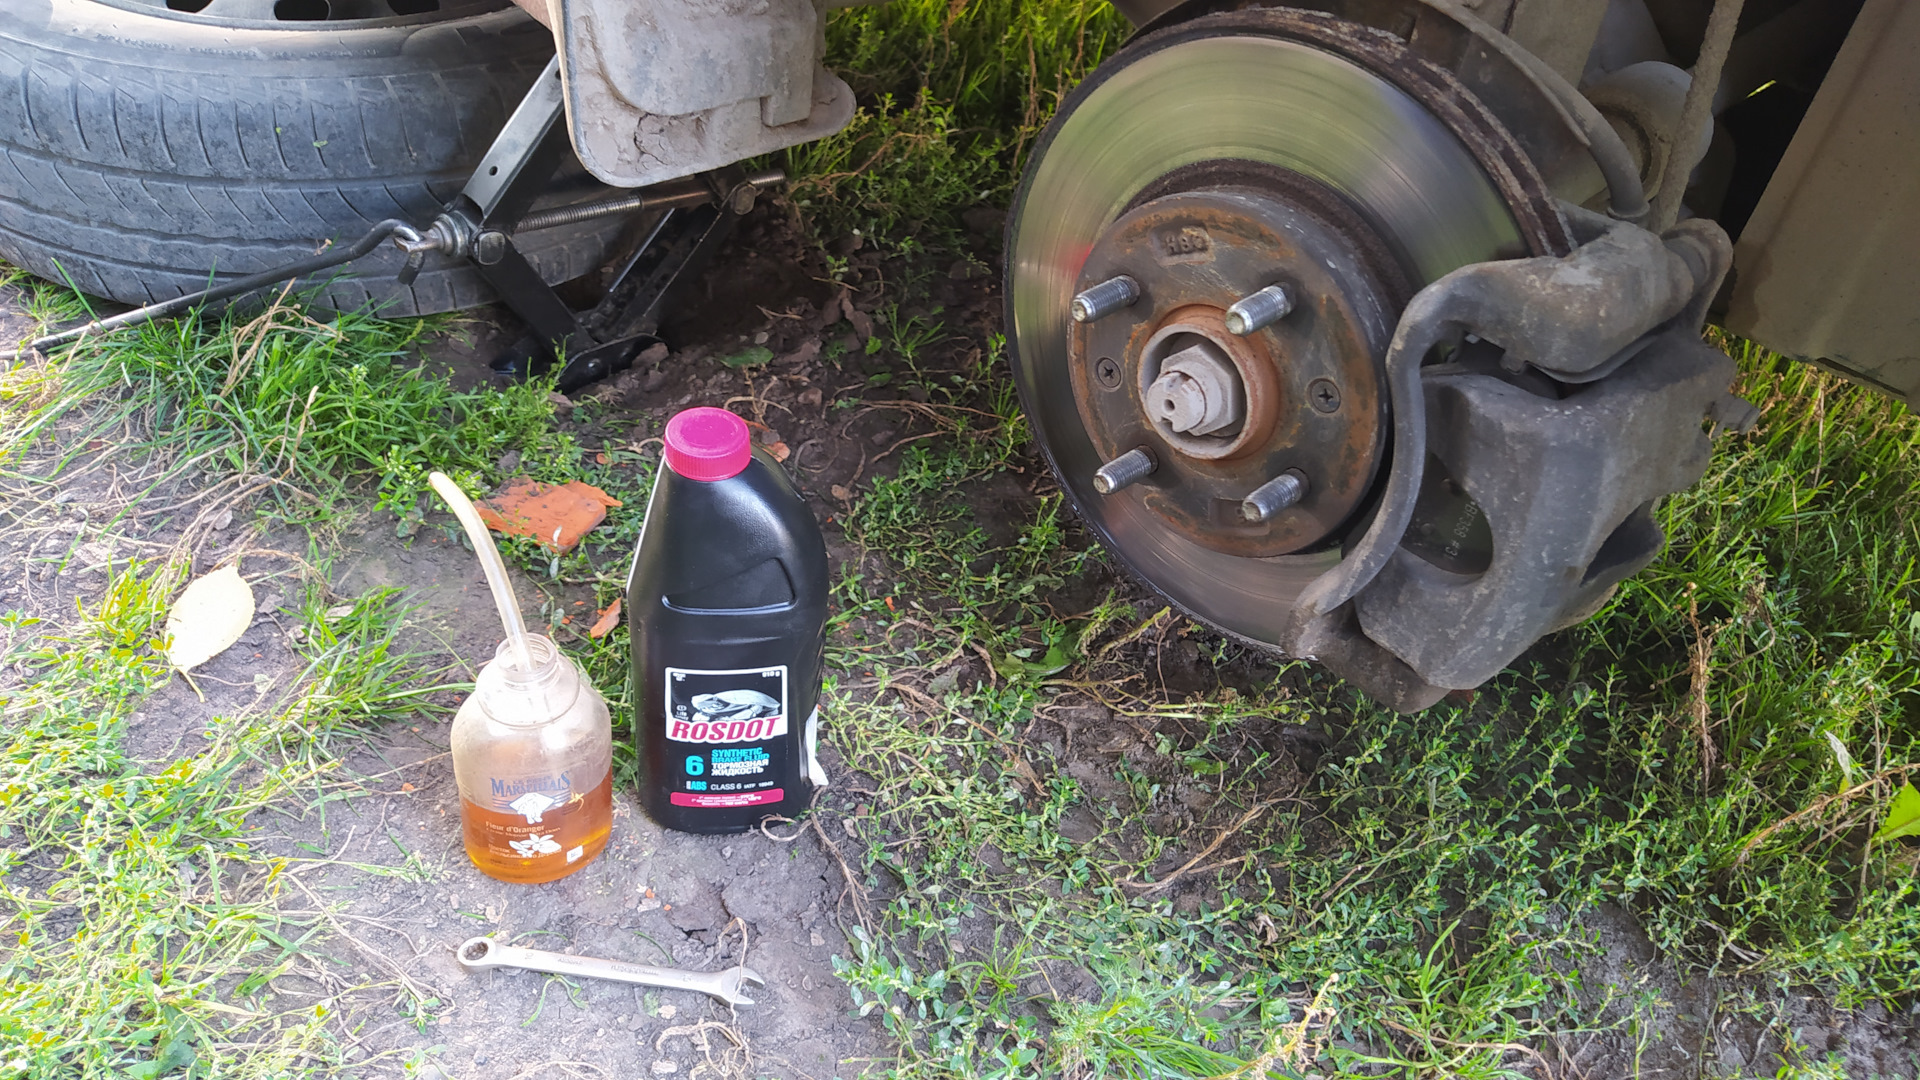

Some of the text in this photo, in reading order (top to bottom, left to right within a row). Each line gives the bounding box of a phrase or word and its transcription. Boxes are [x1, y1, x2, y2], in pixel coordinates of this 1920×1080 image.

[671, 717, 781, 741] ROSDOT
[711, 747, 763, 758] SYNTHETIC
[711, 753, 770, 763] BRAKE FLUID
[685, 755, 704, 776] 6
[711, 759, 769, 770] ТОРМОЗНАЯ
[711, 766, 764, 777] ЖИДКОСТЬ
[690, 781, 707, 791] ABS
[710, 782, 735, 791] CLASS
[736, 782, 742, 790] 6
[485, 821, 504, 831] Fleur
